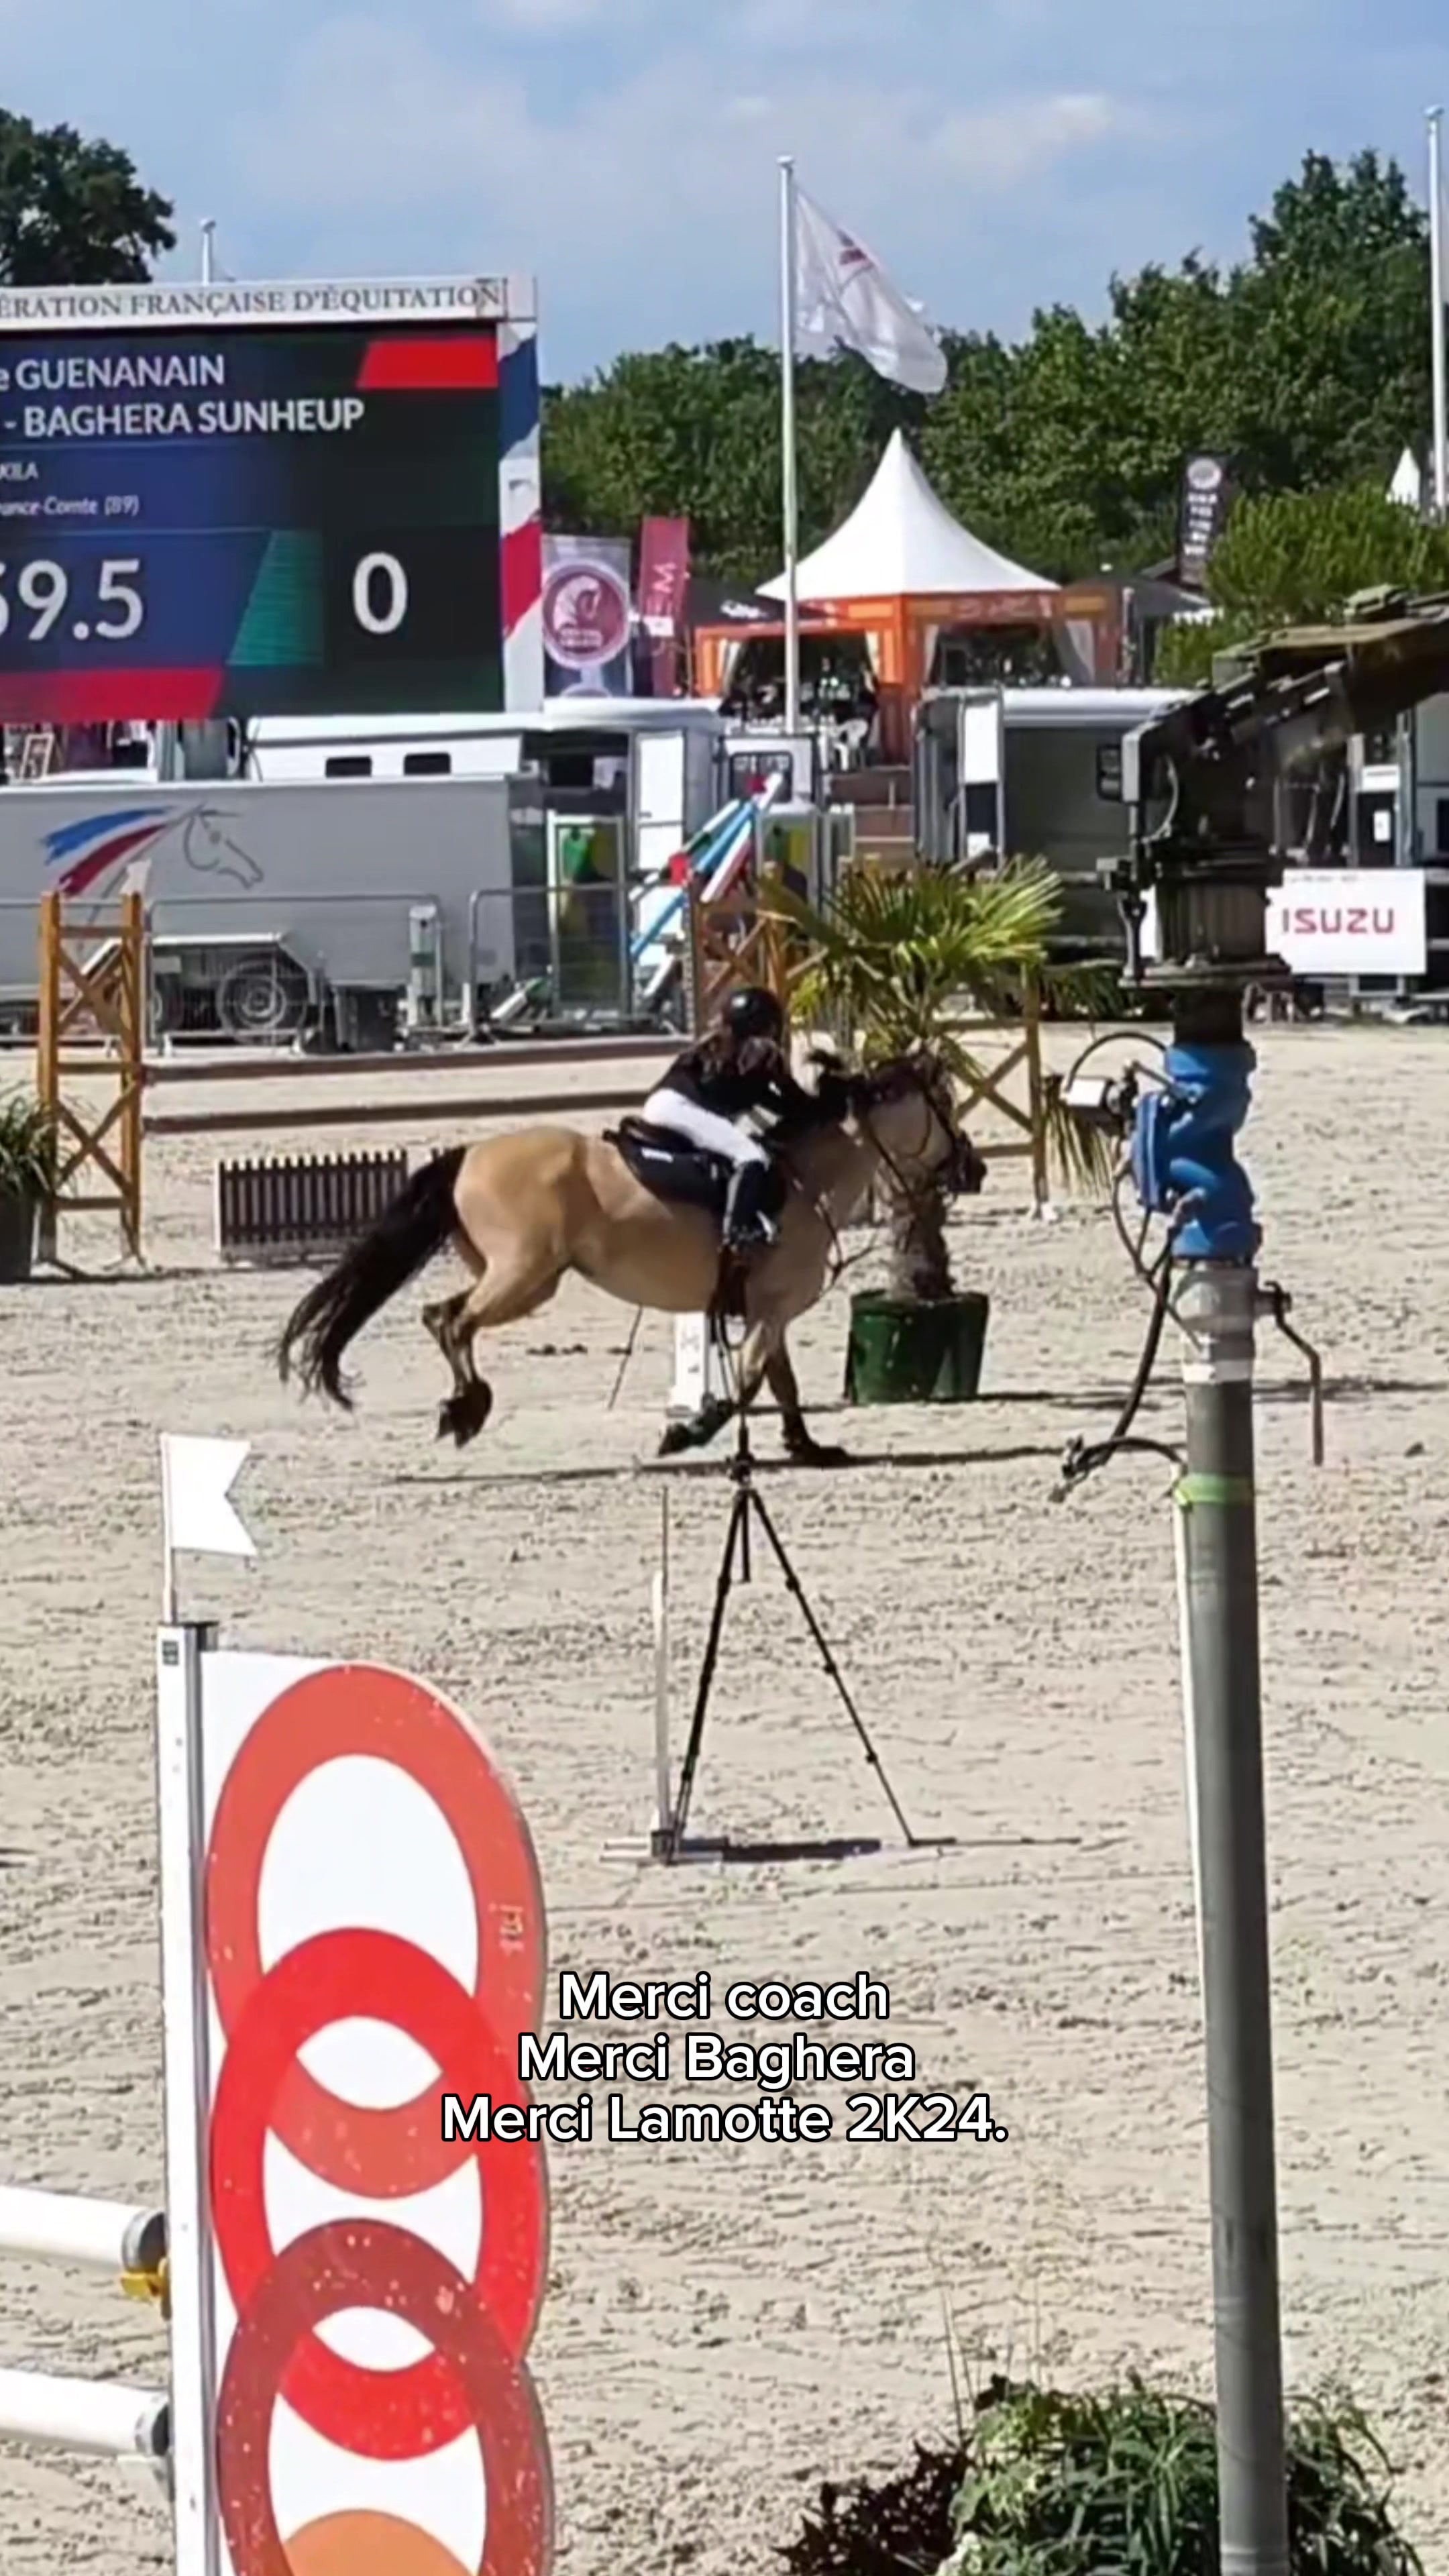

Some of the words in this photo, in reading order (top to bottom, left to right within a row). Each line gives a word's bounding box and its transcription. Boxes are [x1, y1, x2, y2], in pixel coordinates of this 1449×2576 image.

[130, 287, 286, 317] FRANÇAISE
[15, 354, 225, 390] GUENANAIN
[23, 403, 193, 437] BAGHERA
[197, 397, 366, 433] SUNHEUP
[0, 558, 144, 640] 9.5
[353, 551, 407, 635] 0
[1282, 908, 1394, 934] ISUZU
